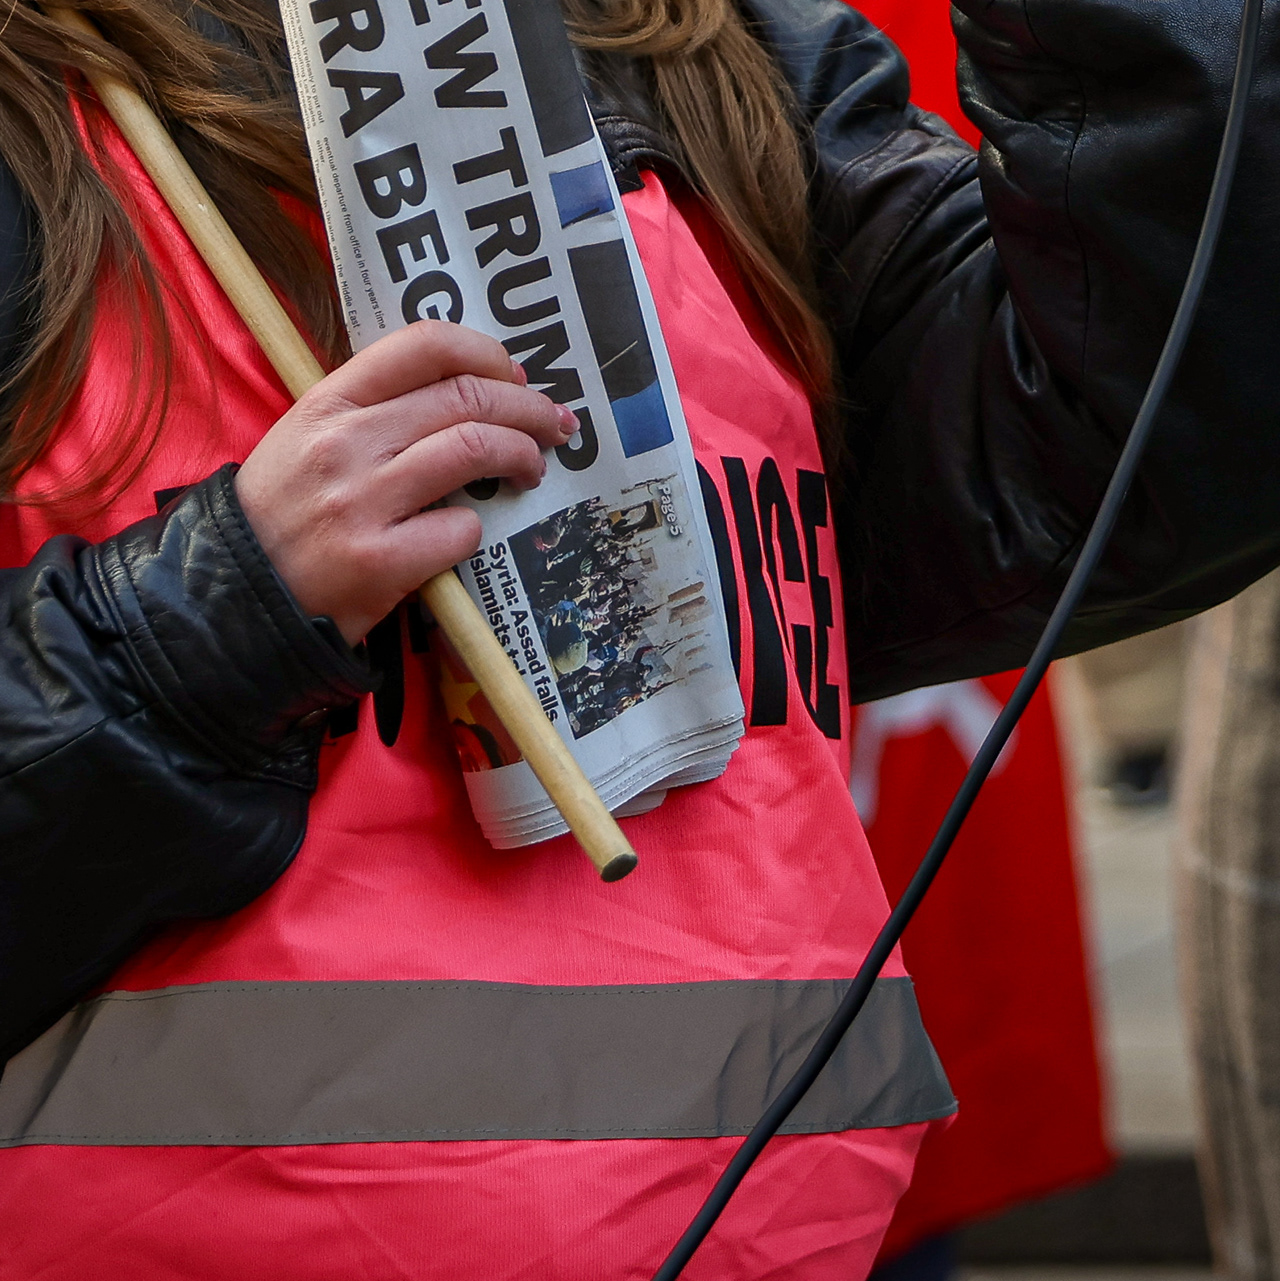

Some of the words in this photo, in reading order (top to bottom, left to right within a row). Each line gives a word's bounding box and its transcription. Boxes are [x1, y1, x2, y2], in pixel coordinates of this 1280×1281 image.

[297, 25, 306, 46] work
[302, 46, 315, 83] tirelessly
[312, 94, 321, 109] put
[323, 136, 338, 172] eventual
[332, 172, 348, 213] departure
[343, 213, 354, 234] from
[349, 235, 362, 259] office
[356, 259, 366, 269] in
[336, 263, 344, 278] the
[340, 280, 353, 307] Middle
[347, 309, 361, 329] East
[360, 268, 372, 286] four
[364, 287, 380, 310] years
[452, 125, 599, 472] TRUMP
[374, 310, 386, 329] time
[657, 484, 677, 525] Page
[669, 523, 683, 537] 5
[469, 548, 512, 648] Islamists
[488, 541, 520, 607] Syria:
[510, 609, 547, 675] Assad
